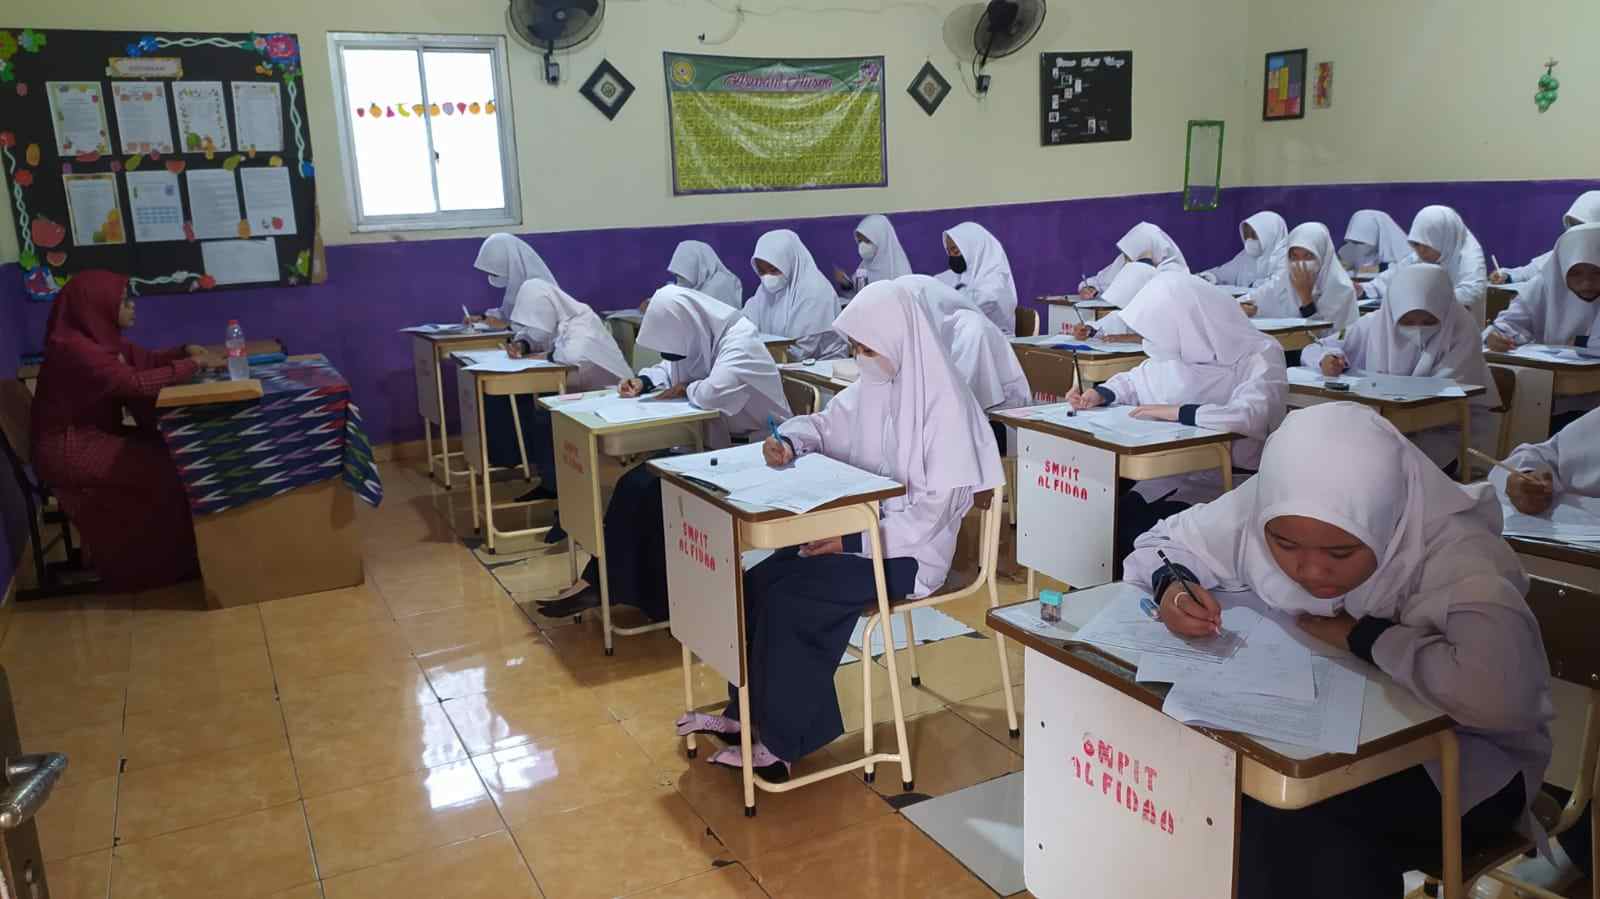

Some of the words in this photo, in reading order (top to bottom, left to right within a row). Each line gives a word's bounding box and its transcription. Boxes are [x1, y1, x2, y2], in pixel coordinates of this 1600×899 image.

[1044, 460, 1080, 481] SMPIT
[1038, 475, 1051, 489] AL
[1082, 732, 1158, 793] SMPIT
